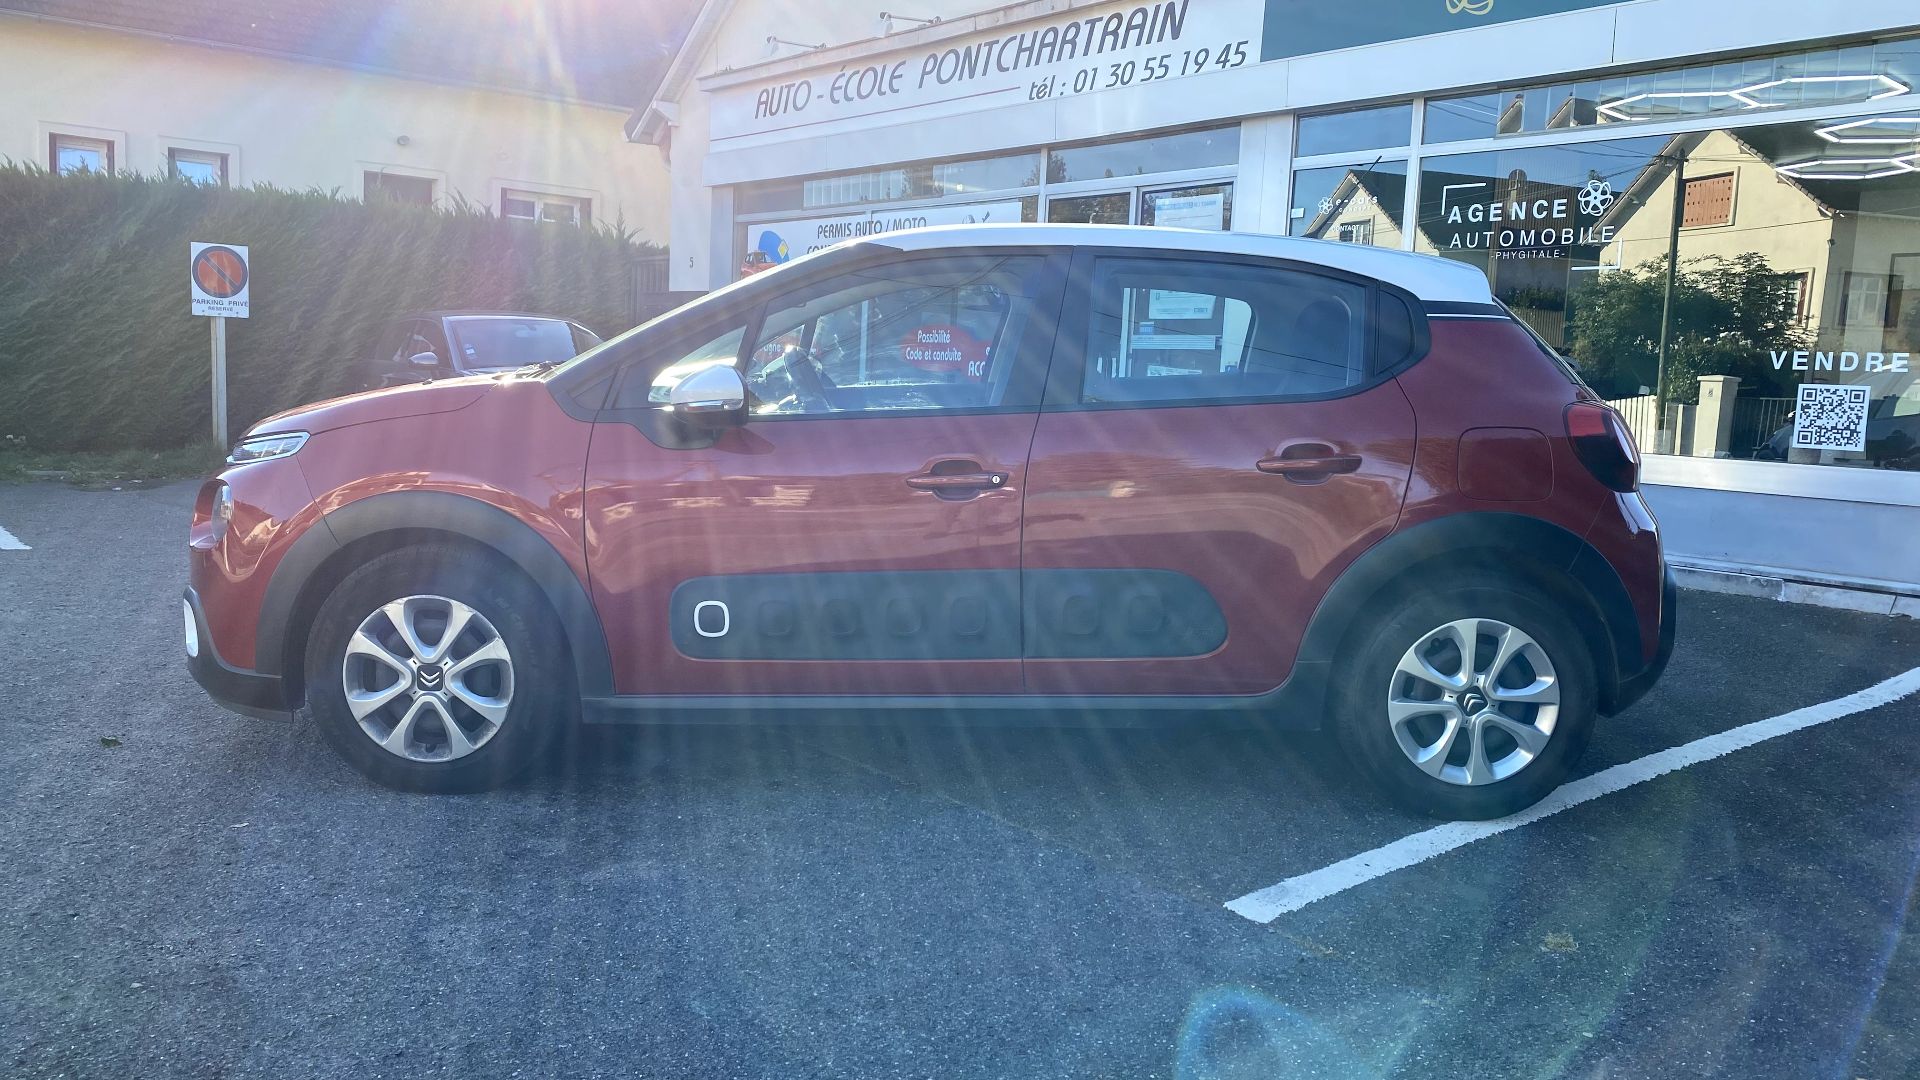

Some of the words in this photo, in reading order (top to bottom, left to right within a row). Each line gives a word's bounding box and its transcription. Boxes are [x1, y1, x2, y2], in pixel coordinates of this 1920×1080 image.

[754, 79, 812, 119] AUTO
[829, 60, 907, 105] ÉCOLE
[918, 0, 1189, 89] PONTCHARTRAIN
[1029, 75, 1056, 101] tél
[1073, 67, 1098, 94] 01
[1105, 60, 1136, 88] 30
[1140, 54, 1172, 83] 55
[1181, 48, 1210, 76] 19
[1215, 40, 1249, 69] 45
[1447, 198, 1568, 224] AGENCE
[817, 222, 852, 239] PERMIS
[855, 220, 883, 237] AUTO
[893, 216, 927, 231] MOTO
[1449, 225, 1615, 249] AUTOMOBILE
[192, 298, 224, 306] PARKING
[917, 329, 951, 343] Possibilité
[905, 347, 923, 360] Code
[924, 349, 932, 360] et
[932, 347, 962, 361] conduite
[1770, 350, 1910, 373] VENDRE
